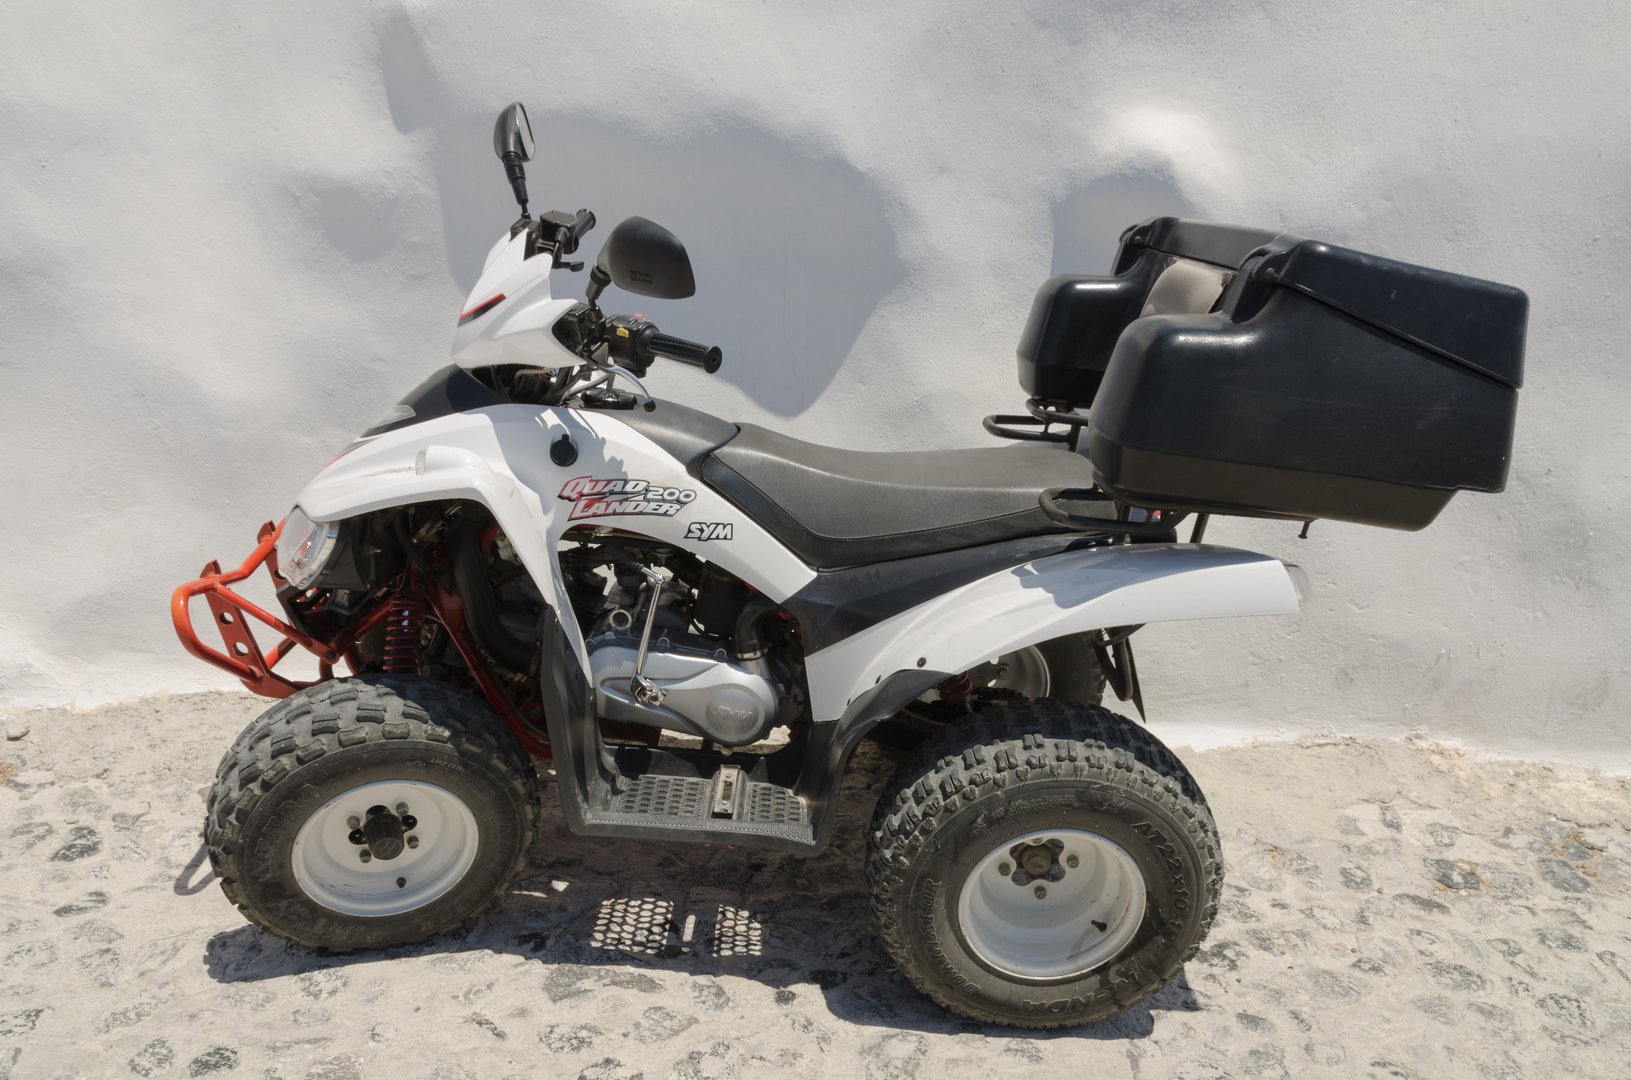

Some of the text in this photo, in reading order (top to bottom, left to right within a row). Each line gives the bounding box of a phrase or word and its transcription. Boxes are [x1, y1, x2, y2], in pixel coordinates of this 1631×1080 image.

[558, 476, 697, 502] QUAD 200
[567, 499, 684, 521] LANDER
[684, 522, 733, 541] SYM
